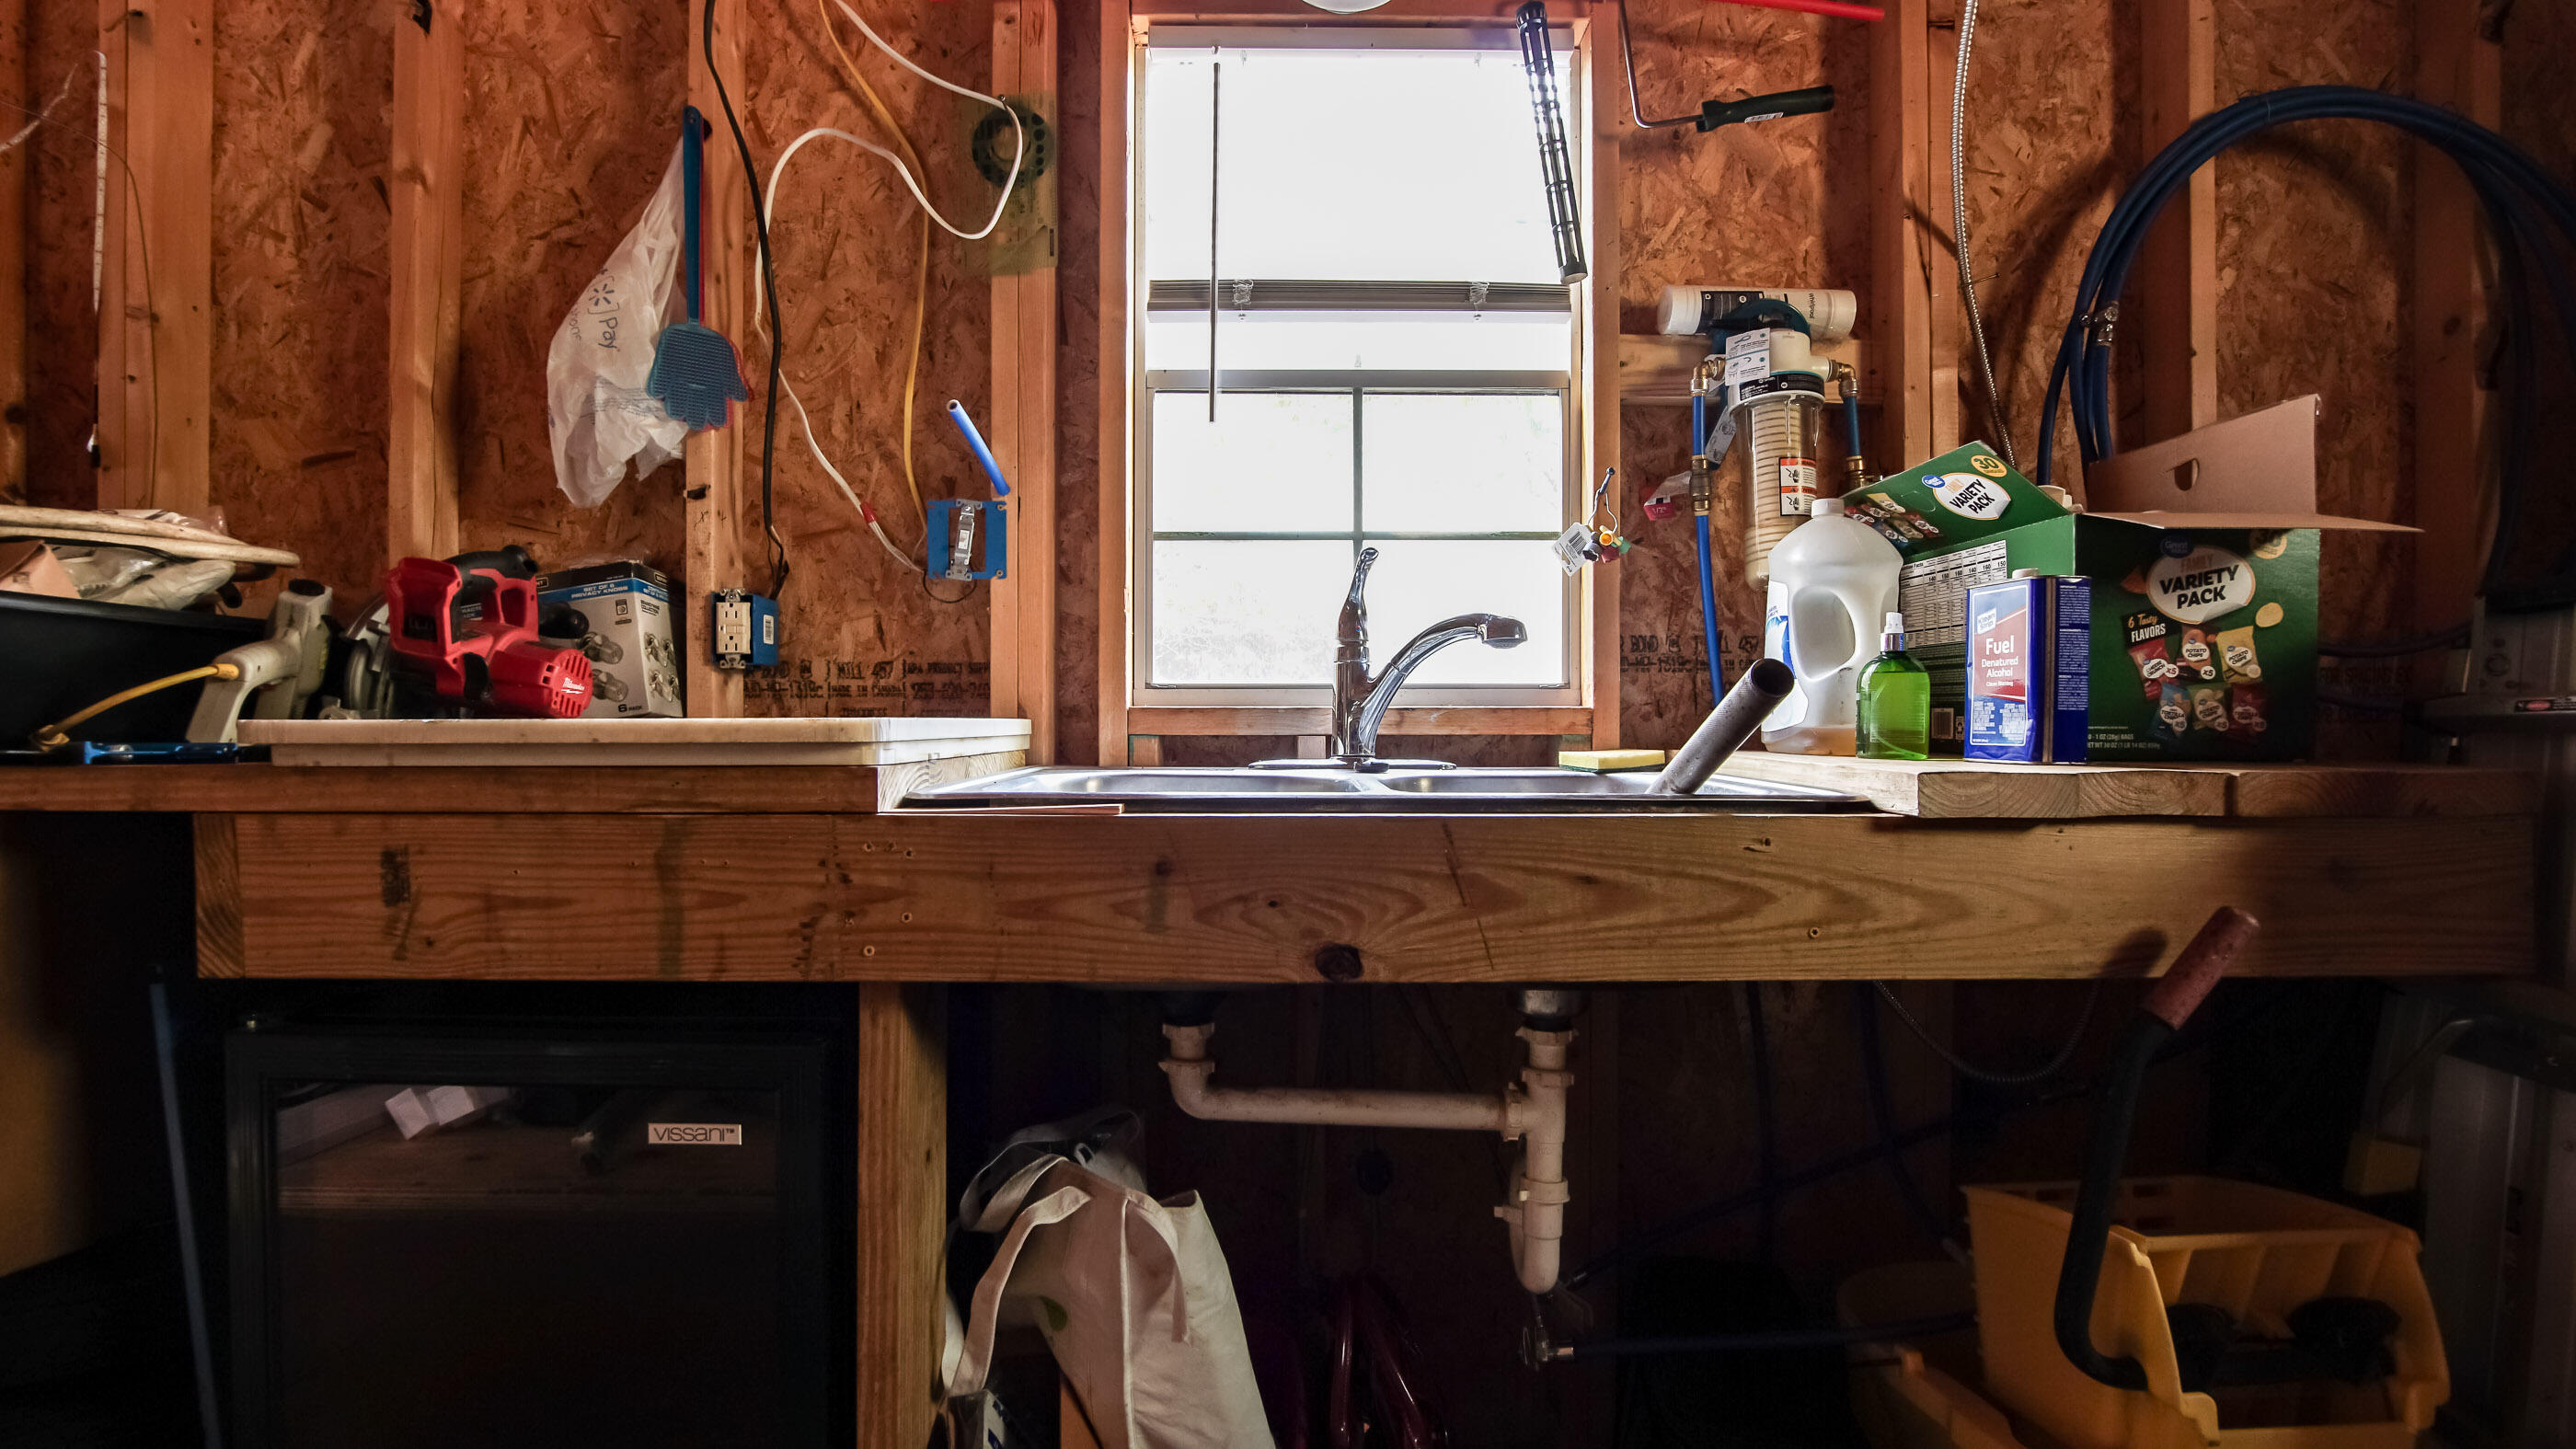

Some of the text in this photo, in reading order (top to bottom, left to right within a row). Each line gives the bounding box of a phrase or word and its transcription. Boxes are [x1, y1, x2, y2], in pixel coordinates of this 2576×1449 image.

[1972, 457, 1998, 470] 30
[1949, 478, 1987, 510] VARIETY
[1967, 492, 1995, 514] PACK
[2158, 564, 2239, 595] VARIETY
[2177, 585, 2226, 610] PACK
[2127, 614, 2158, 628] 6 Tasty
[2131, 624, 2167, 642] FLAVORS
[1985, 635, 2015, 656] Fuel
[1981, 656, 2018, 669] Denatured
[1986, 668, 2014, 678] Alcohol
[617, 704, 627, 713] 6
